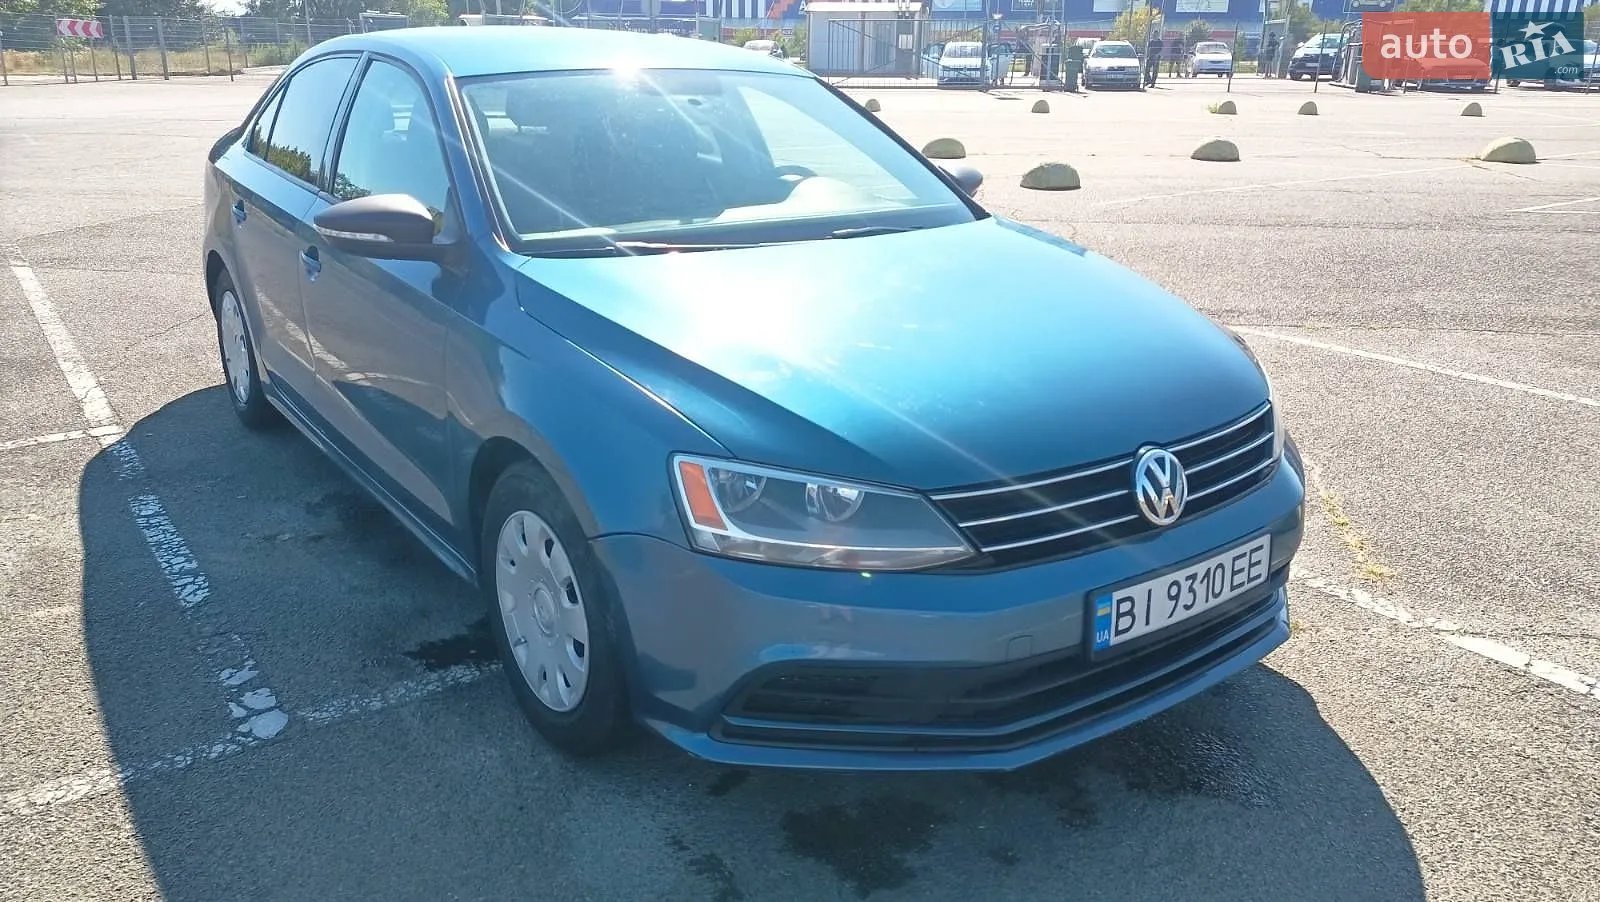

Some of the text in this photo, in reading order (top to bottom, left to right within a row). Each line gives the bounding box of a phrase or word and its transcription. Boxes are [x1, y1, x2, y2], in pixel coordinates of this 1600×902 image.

[1114, 588, 1152, 638] BI
[1167, 562, 1226, 619] 9310
[1096, 629, 1110, 643] UA
